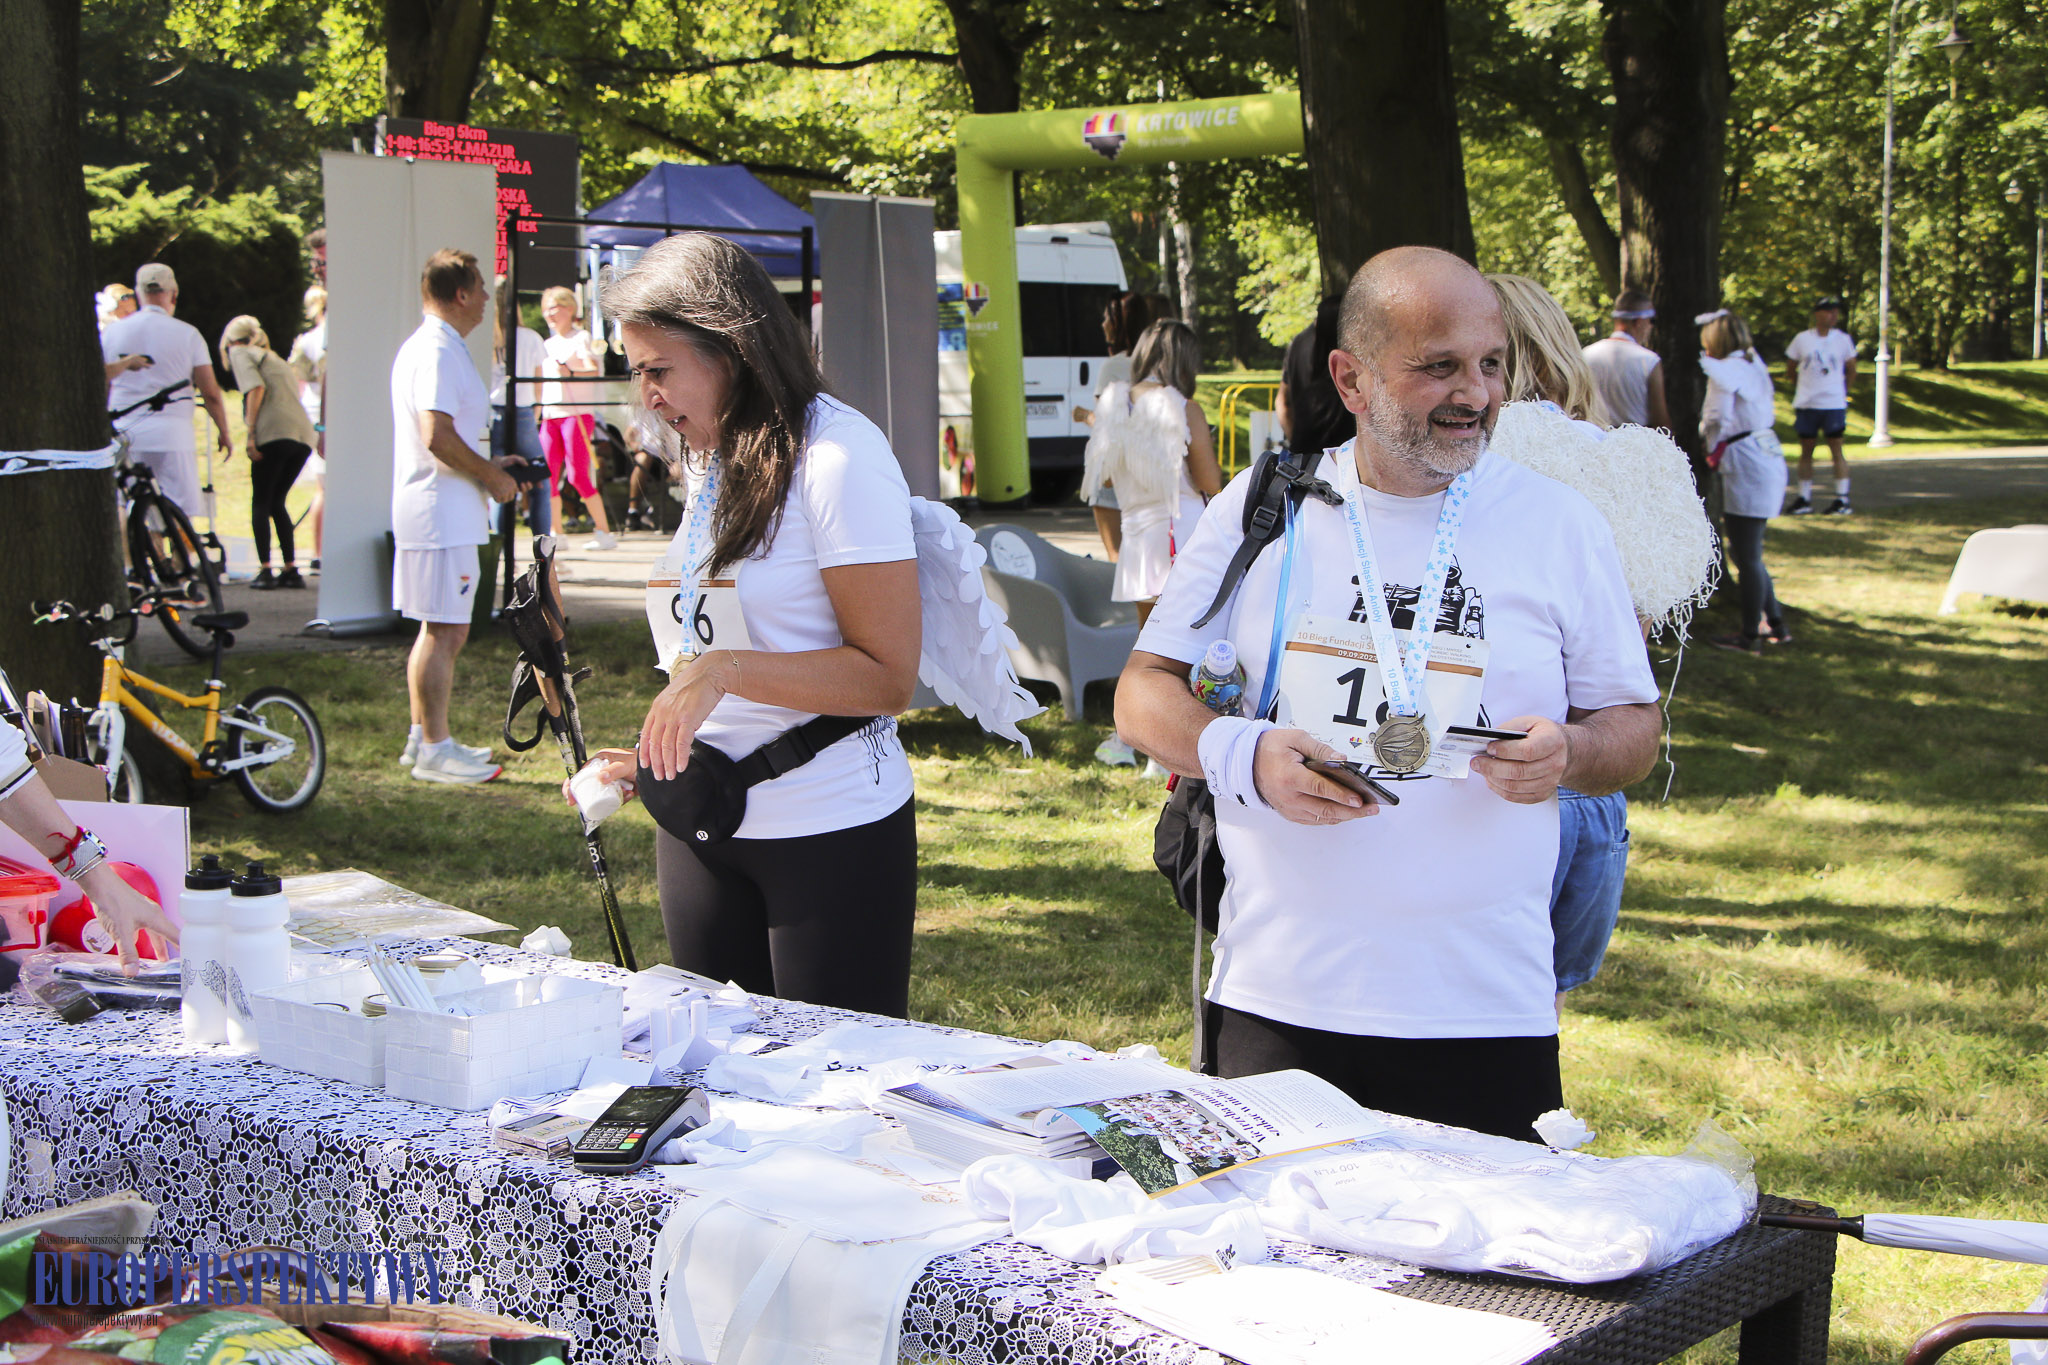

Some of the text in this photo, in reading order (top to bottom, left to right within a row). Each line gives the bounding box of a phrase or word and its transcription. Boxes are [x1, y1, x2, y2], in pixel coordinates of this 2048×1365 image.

[1136, 106, 1240, 133] KATOWICE
[423, 121, 488, 141] Bieg 5km
[1297, 631, 1308, 640] 10
[1309, 632, 1328, 645] Bieg
[1329, 636, 1365, 650] Fundacji
